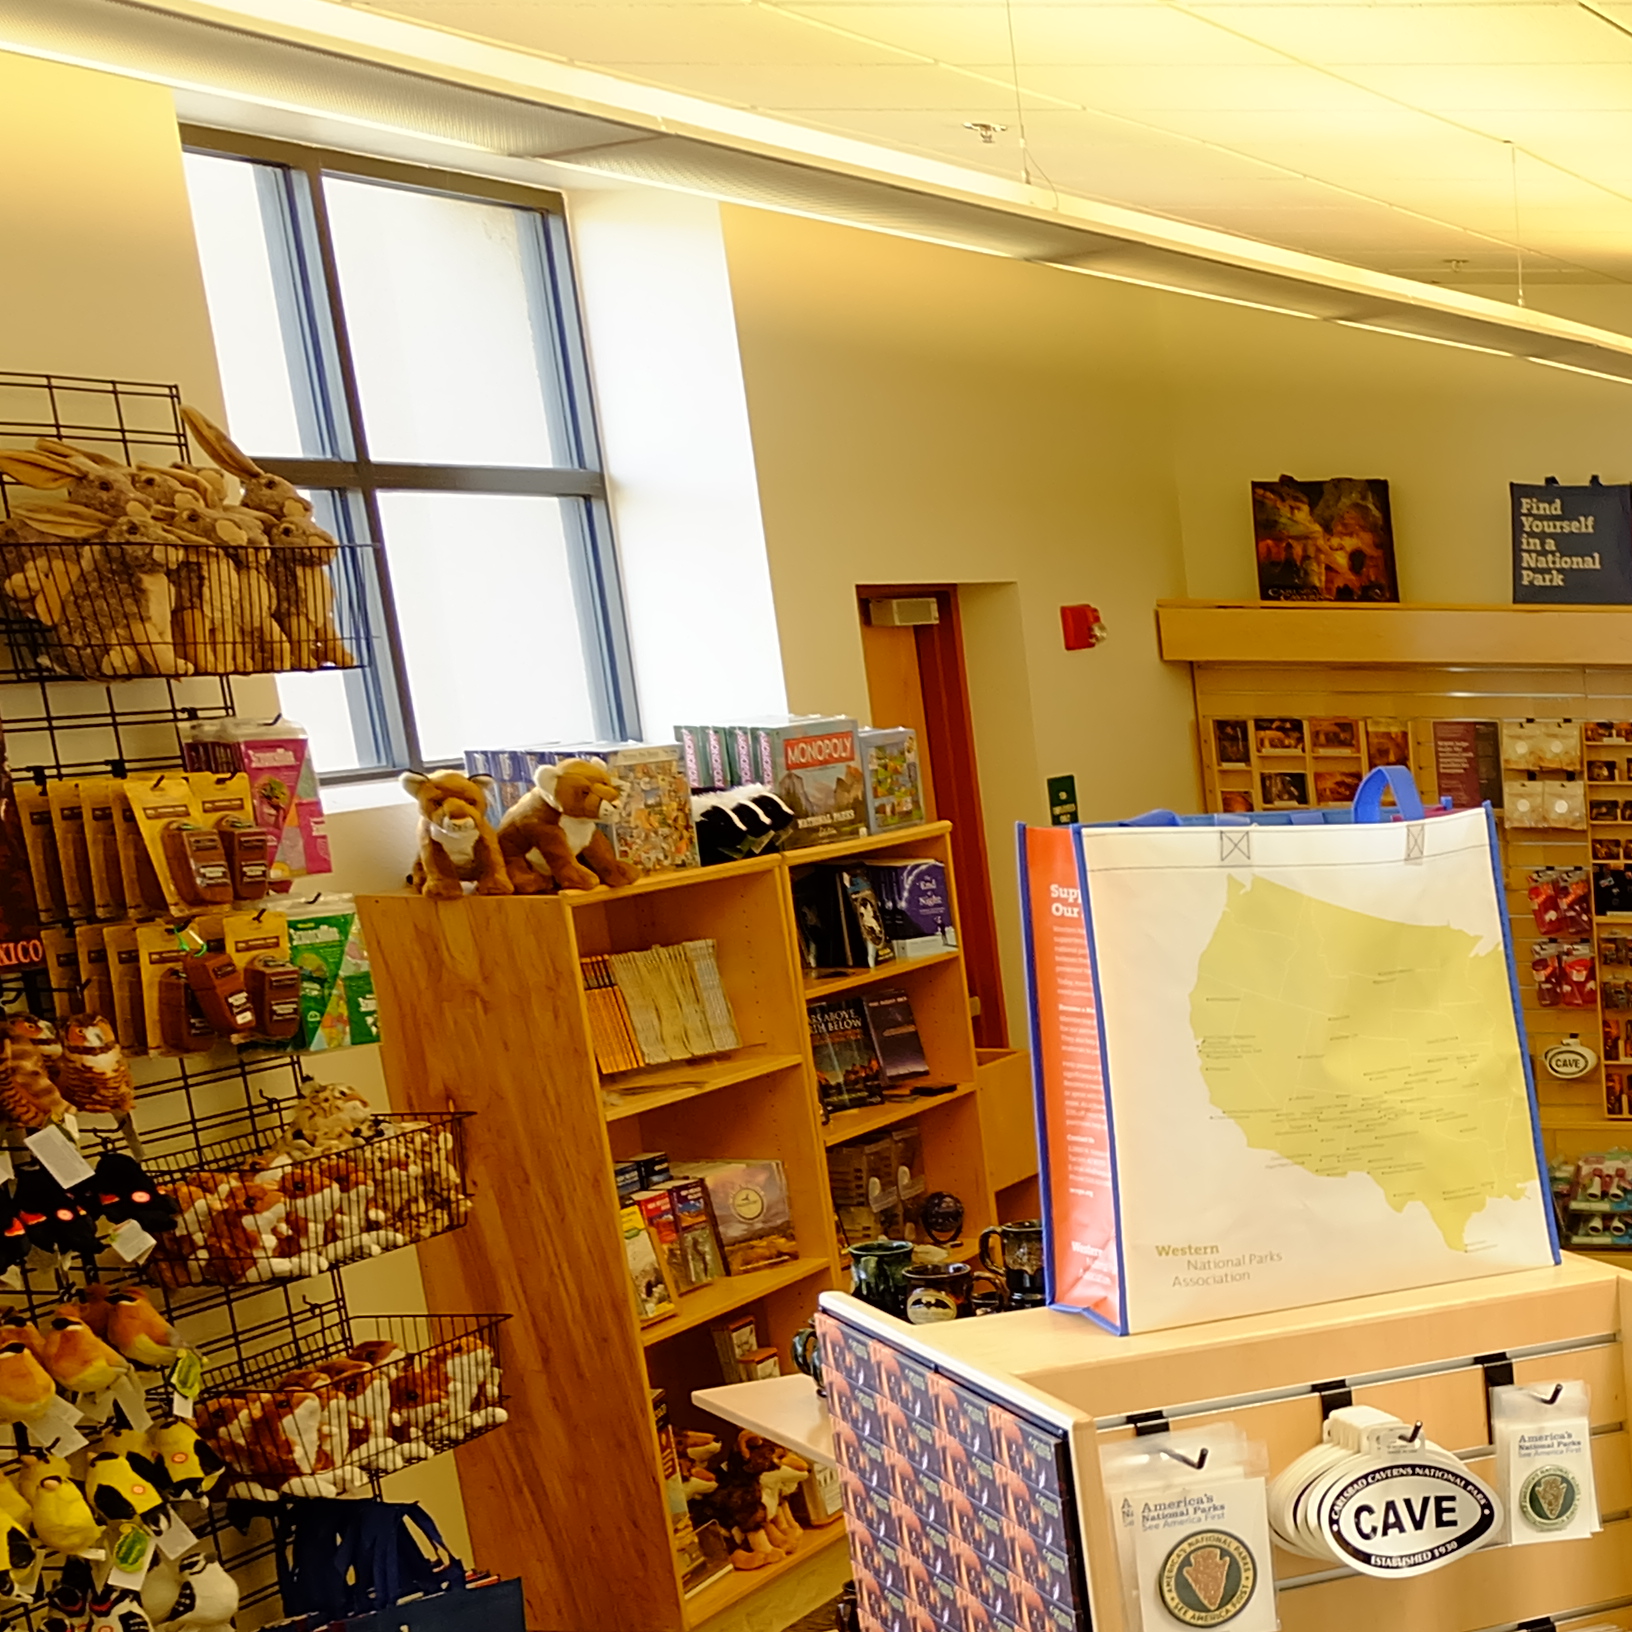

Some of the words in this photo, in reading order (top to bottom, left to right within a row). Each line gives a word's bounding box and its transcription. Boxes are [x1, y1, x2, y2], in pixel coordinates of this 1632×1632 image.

[1520, 497, 1562, 515] Find
[1520, 516, 1594, 534] Yourself
[1521, 535, 1540, 550] in
[1545, 538, 1556, 551] a
[1521, 552, 1601, 569] National
[1521, 570, 1565, 587] Park
[785, 738, 853, 766] MONOPOLY
[1051, 903, 1079, 917] Our
[1555, 1058, 1580, 1068] CAVE
[1155, 1243, 1220, 1257] Western
[1187, 1255, 1245, 1271] National
[1249, 1250, 1283, 1266] Parks
[1171, 1269, 1251, 1288] Association
[1331, 1479, 1368, 1520] CARLSBAD
[1368, 1467, 1413, 1483] CAVERNS
[1415, 1467, 1466, 1488] NATIONAL
[1466, 1484, 1489, 1505] PARK
[1141, 1493, 1214, 1515] America's
[1142, 1508, 1190, 1523] National
[1193, 1503, 1226, 1515] Parks
[1163, 1516, 1202, 1529] America
[1353, 1495, 1459, 1541] CAVE
[1187, 1534, 1233, 1549] NATIONAL
[1370, 1552, 1432, 1568] ESTABLISHED
[1434, 1541, 1459, 1557] 1930
[1190, 1608, 1231, 1623] AMERICA
